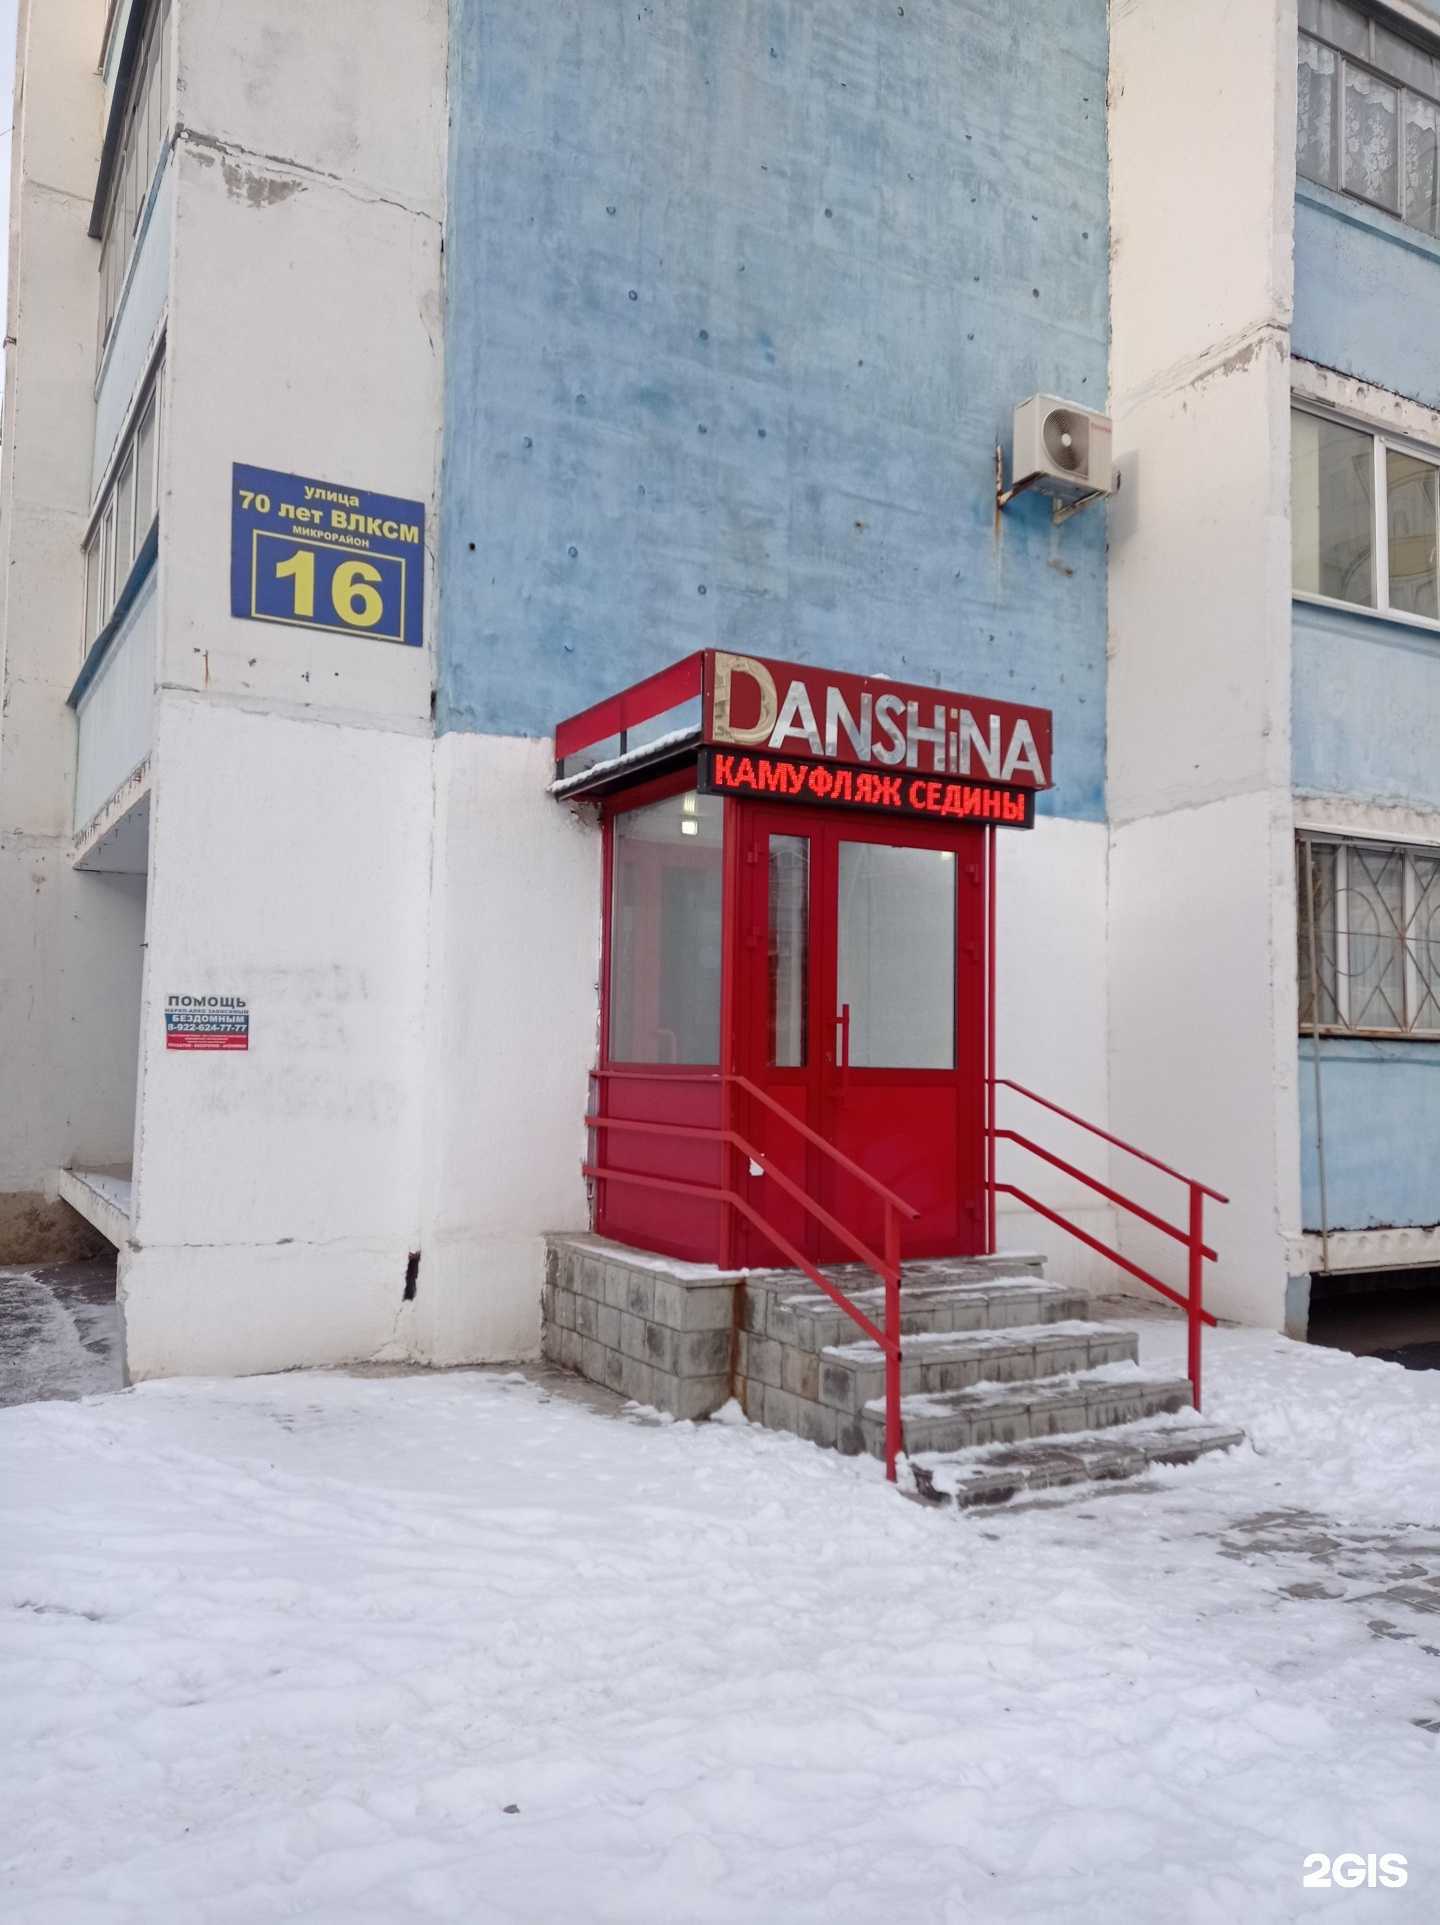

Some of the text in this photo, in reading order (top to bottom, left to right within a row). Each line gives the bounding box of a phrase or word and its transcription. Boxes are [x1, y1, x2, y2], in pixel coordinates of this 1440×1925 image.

[304, 485, 360, 507] улица
[239, 490, 419, 544] 70 лет ВЛКСМ
[292, 525, 370, 547] МИКРОРАЙОН
[275, 550, 384, 627] 16
[714, 754, 1026, 822] КАМУФЛЯЖ СЕДИНЫ
[168, 996, 246, 1009] ПОМОЩЬ
[167, 1023, 248, 1032] 8-922-624-77-77
[171, 1014, 246, 1023] БЕЗДОМНЫМ
